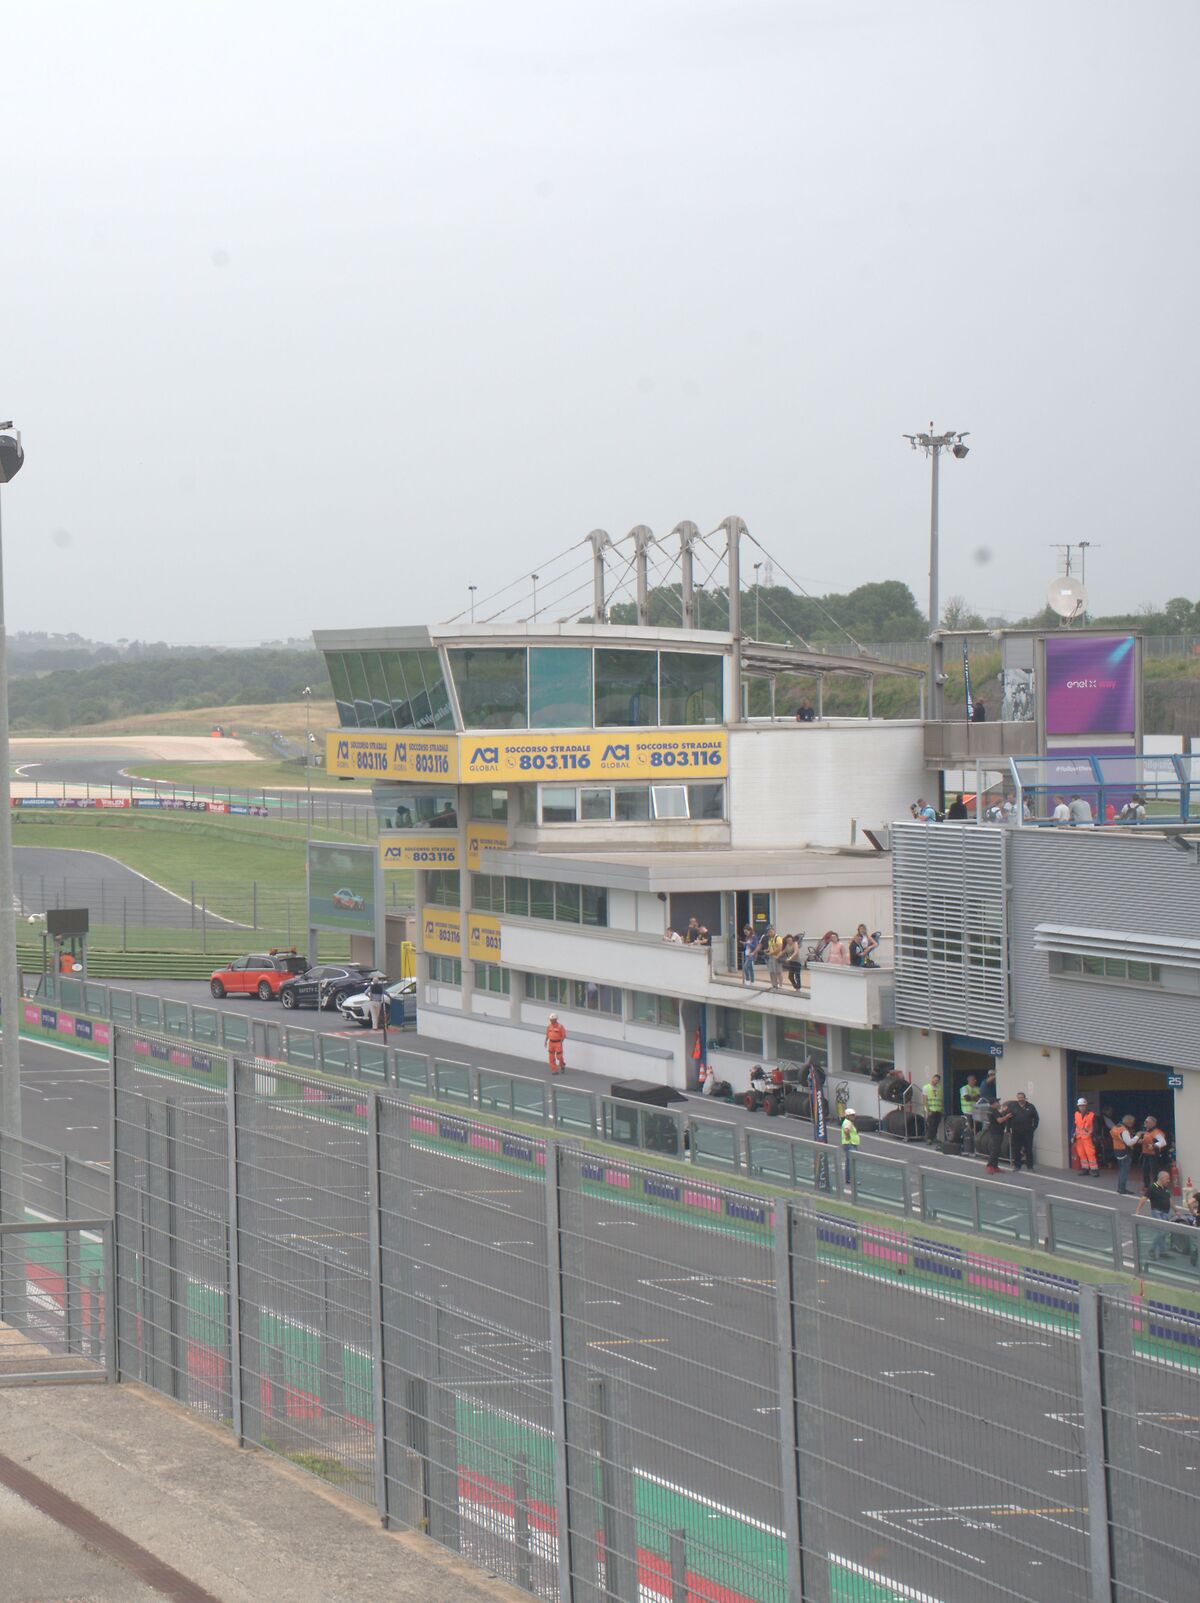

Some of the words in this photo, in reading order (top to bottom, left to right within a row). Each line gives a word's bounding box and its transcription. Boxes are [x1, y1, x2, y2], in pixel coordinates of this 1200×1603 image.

[519, 754, 591, 770] 803.116
[650, 750, 722, 767] 803.116
[990, 1046, 1002, 1055] 26
[1168, 1076, 1182, 1086] 25
